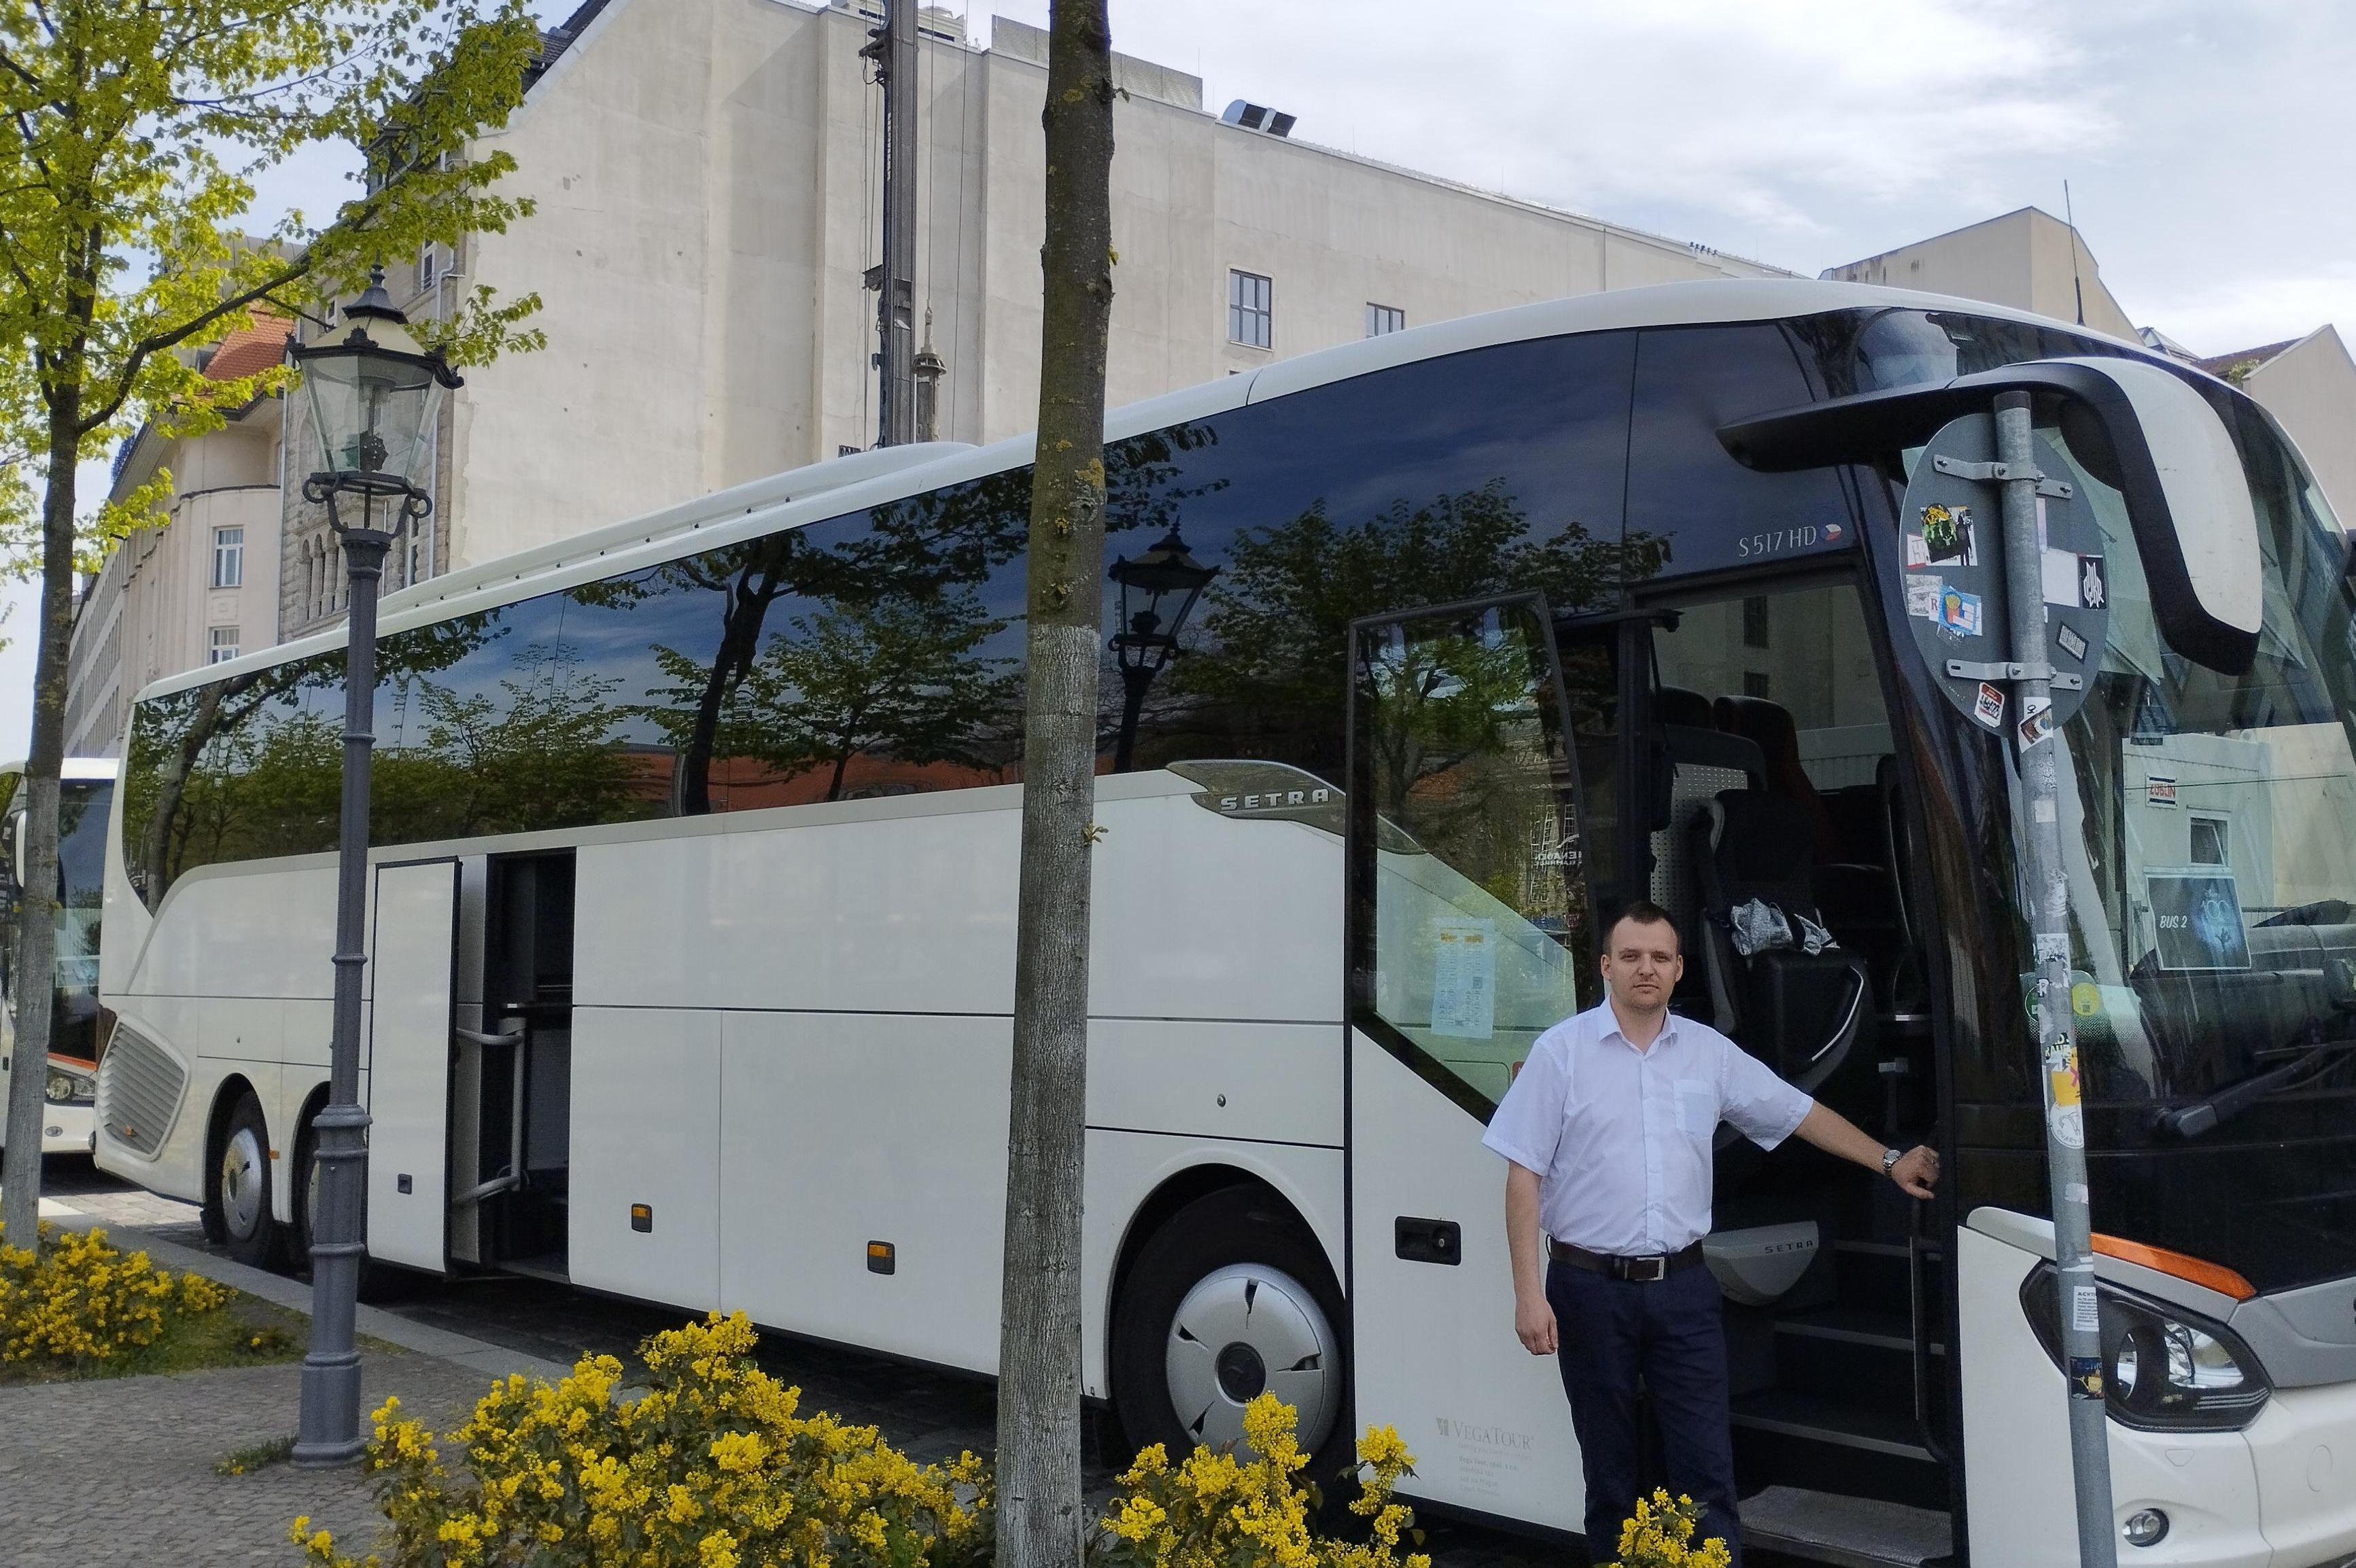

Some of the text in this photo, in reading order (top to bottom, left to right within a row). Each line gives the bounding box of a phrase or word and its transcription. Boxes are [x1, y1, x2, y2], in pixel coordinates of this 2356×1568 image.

[1739, 526, 1817, 557] S 517 HD
[1220, 788, 1330, 811] SETRA
[2160, 915, 2187, 928] BUS 2
[1764, 1240, 1814, 1254] SETRA
